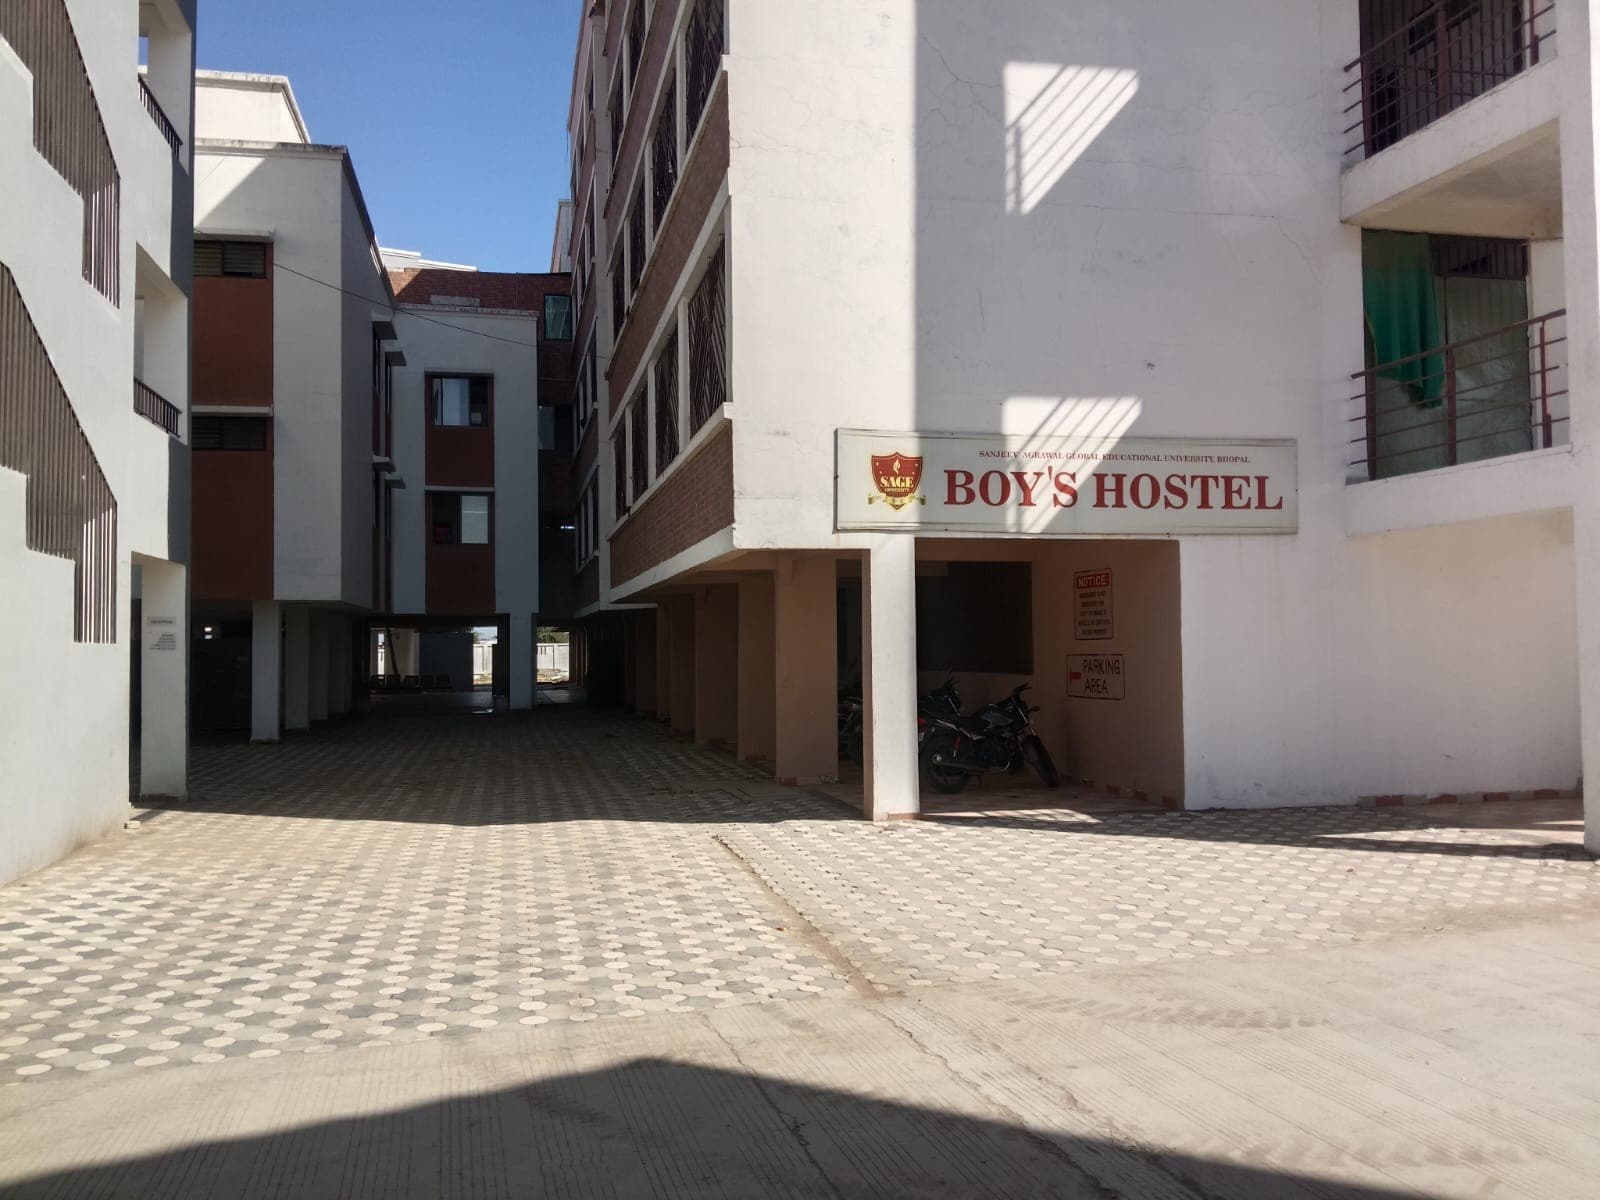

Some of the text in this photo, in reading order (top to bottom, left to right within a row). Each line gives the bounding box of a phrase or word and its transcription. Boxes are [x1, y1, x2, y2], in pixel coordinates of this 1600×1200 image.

[979, 450, 1019, 459] SANJEEV
[1022, 451, 1064, 460] AGRAWAL
[1066, 453, 1099, 461] GLOBAL
[1102, 453, 1162, 462] EDUCATIONAL
[880, 476, 914, 488] SAGE
[943, 465, 1283, 510] BOY'S HOSTEL
[1078, 575, 1108, 587] NOTICE
[1083, 659, 1120, 674] PARKING
[1084, 678, 1109, 693] AREA
